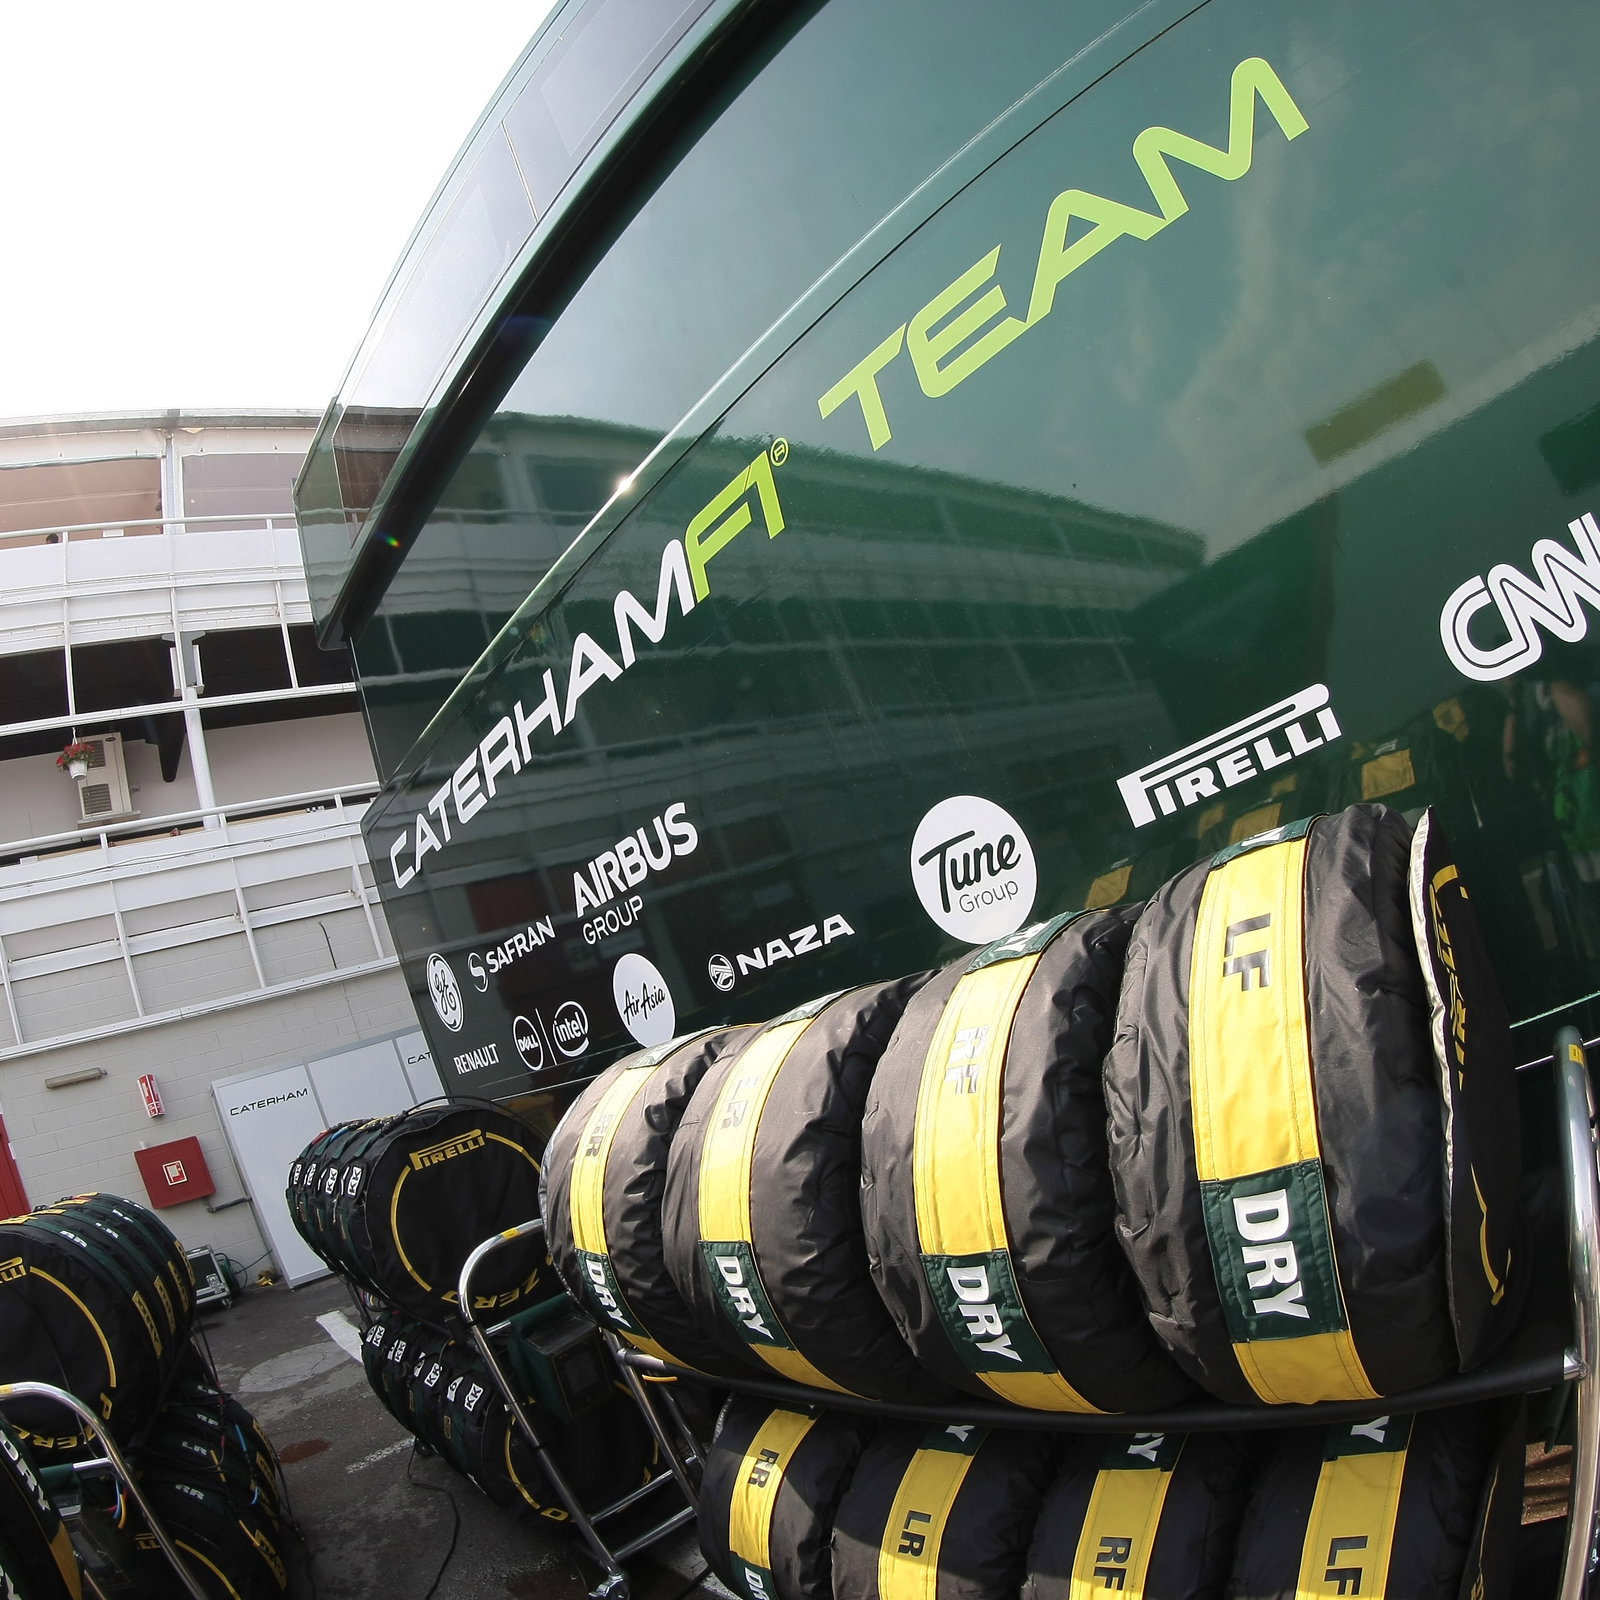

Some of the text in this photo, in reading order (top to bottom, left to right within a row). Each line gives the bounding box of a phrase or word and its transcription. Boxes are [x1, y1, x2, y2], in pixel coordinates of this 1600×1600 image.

[817, 57, 1309, 451] TEAM
[1116, 683, 1342, 828] PIRELLI
[573, 802, 698, 918] AIRBUS
[919, 830, 1022, 914] Tune
[583, 895, 643, 945] GROUP
[959, 878, 1019, 913] Group
[485, 915, 555, 974] SAFRAN
[736, 914, 856, 976] NAZA
[1223, 913, 1271, 991] LF
[517, 1034, 539, 1053] DELL
[553, 1011, 586, 1043] intel
[454, 1043, 500, 1075] RENAULT
[945, 1024, 990, 1095] RF
[230, 1088, 308, 1116] CATERHAM
[409, 1129, 485, 1171] PIRELLI
[1232, 1188, 1311, 1319] DRY
[586, 1259, 632, 1329] DRY
[715, 1255, 775, 1340] DRY
[946, 1265, 1023, 1363] DRY
[748, 1448, 780, 1489] RR
[898, 1509, 932, 1557] LR
[1093, 1536, 1132, 1591] RF
[1324, 1535, 1368, 1596] LF
